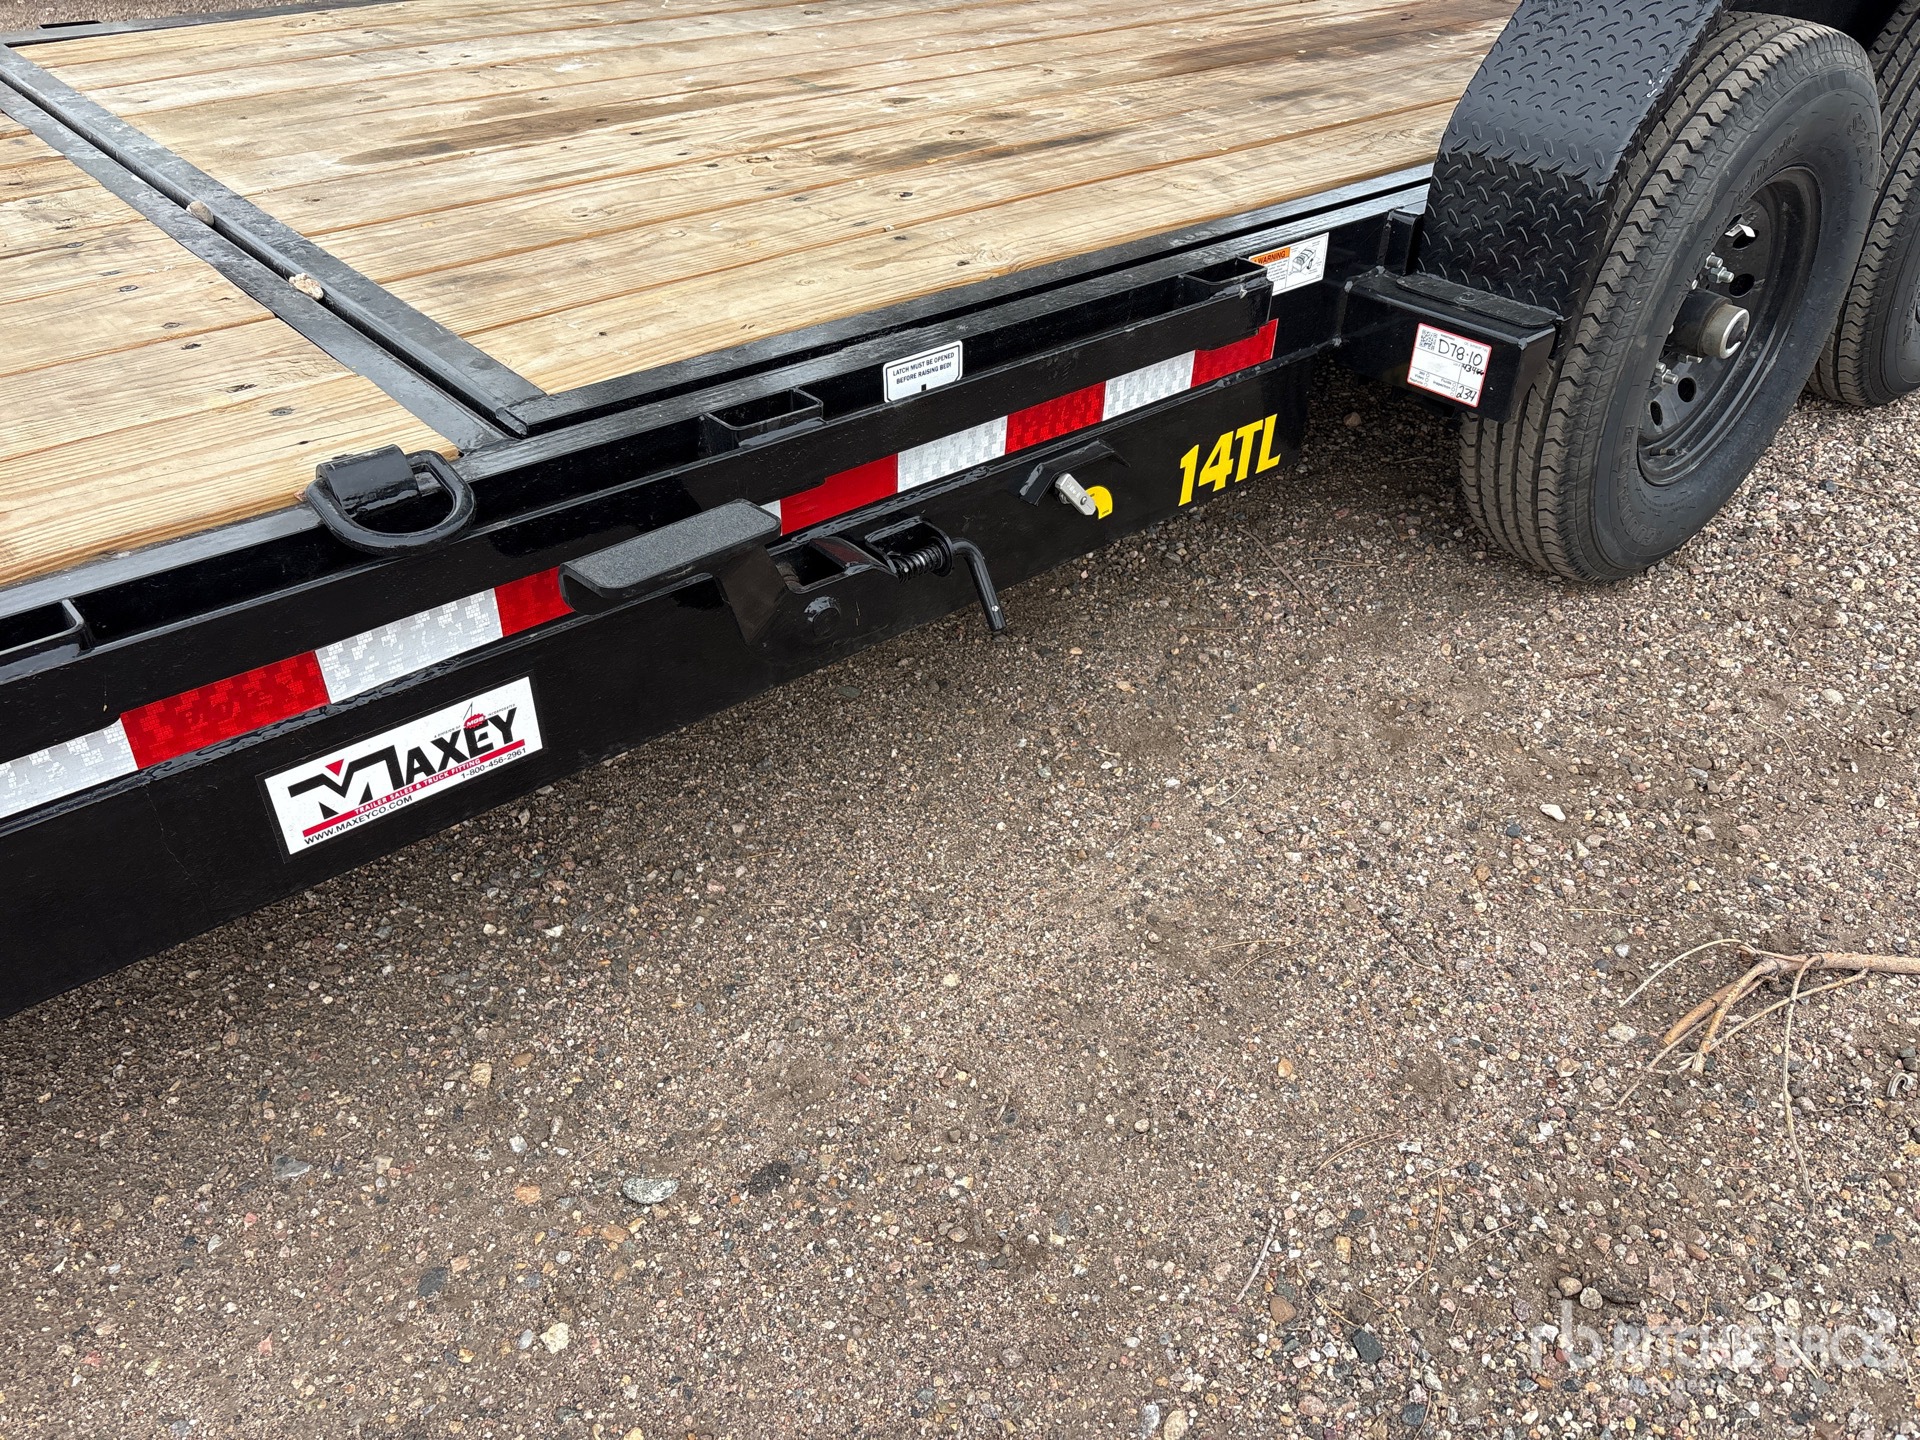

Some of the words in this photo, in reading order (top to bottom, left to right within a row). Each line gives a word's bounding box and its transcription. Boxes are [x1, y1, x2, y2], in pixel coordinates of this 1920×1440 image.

[1258, 250, 1286, 264] WARNING
[893, 365, 910, 376] LATCH
[910, 361, 925, 371] MUST
[934, 352, 955, 363] OPENED
[896, 373, 917, 384] BEFORE
[918, 366, 939, 377] RAISING
[1456, 385, 1477, 402] 234
[1178, 413, 1281, 506] 14TL
[466, 715, 484, 727] MGS
[287, 707, 517, 820] MAXEY
[460, 747, 527, 779] 1-800-456-2961
[354, 797, 388, 815] TRAILER
[389, 786, 414, 800] SALES
[423, 772, 449, 786] TRUCK
[451, 758, 481, 775] FITTING
[304, 794, 413, 845] WWW.MAXEYCO.COM
